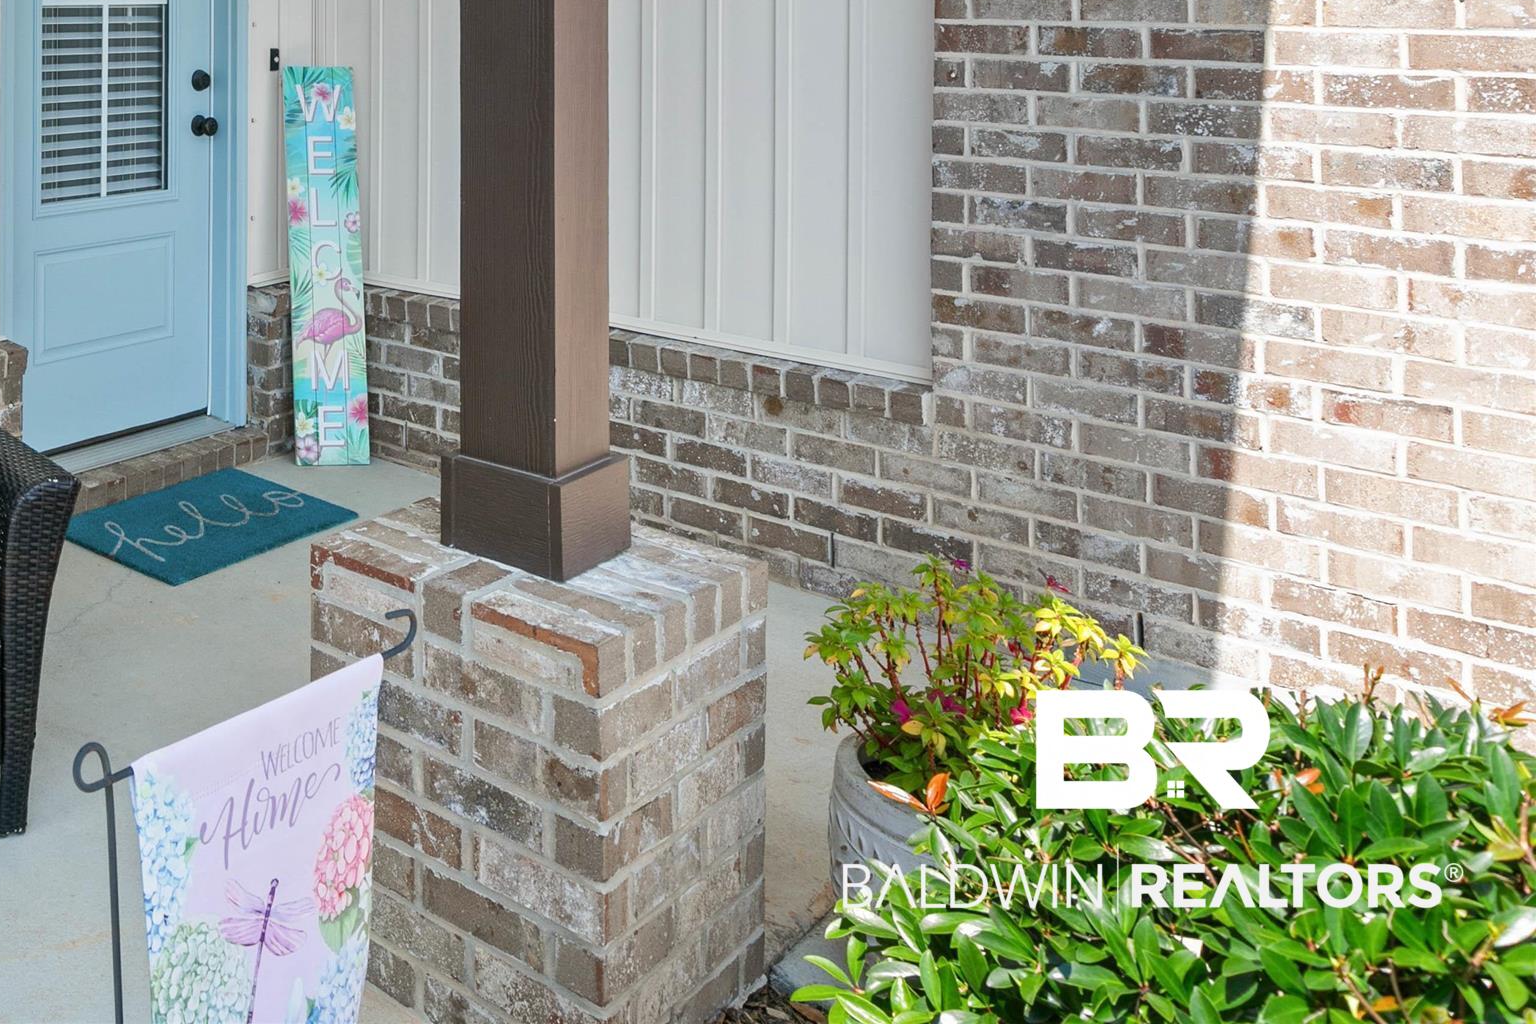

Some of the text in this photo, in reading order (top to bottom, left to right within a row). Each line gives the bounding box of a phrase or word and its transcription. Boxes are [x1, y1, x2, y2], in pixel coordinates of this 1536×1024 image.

[295, 83, 351, 450] WELCME
[103, 490, 305, 562] hello
[261, 717, 341, 779] WELCOME
[199, 762, 341, 870] Home
